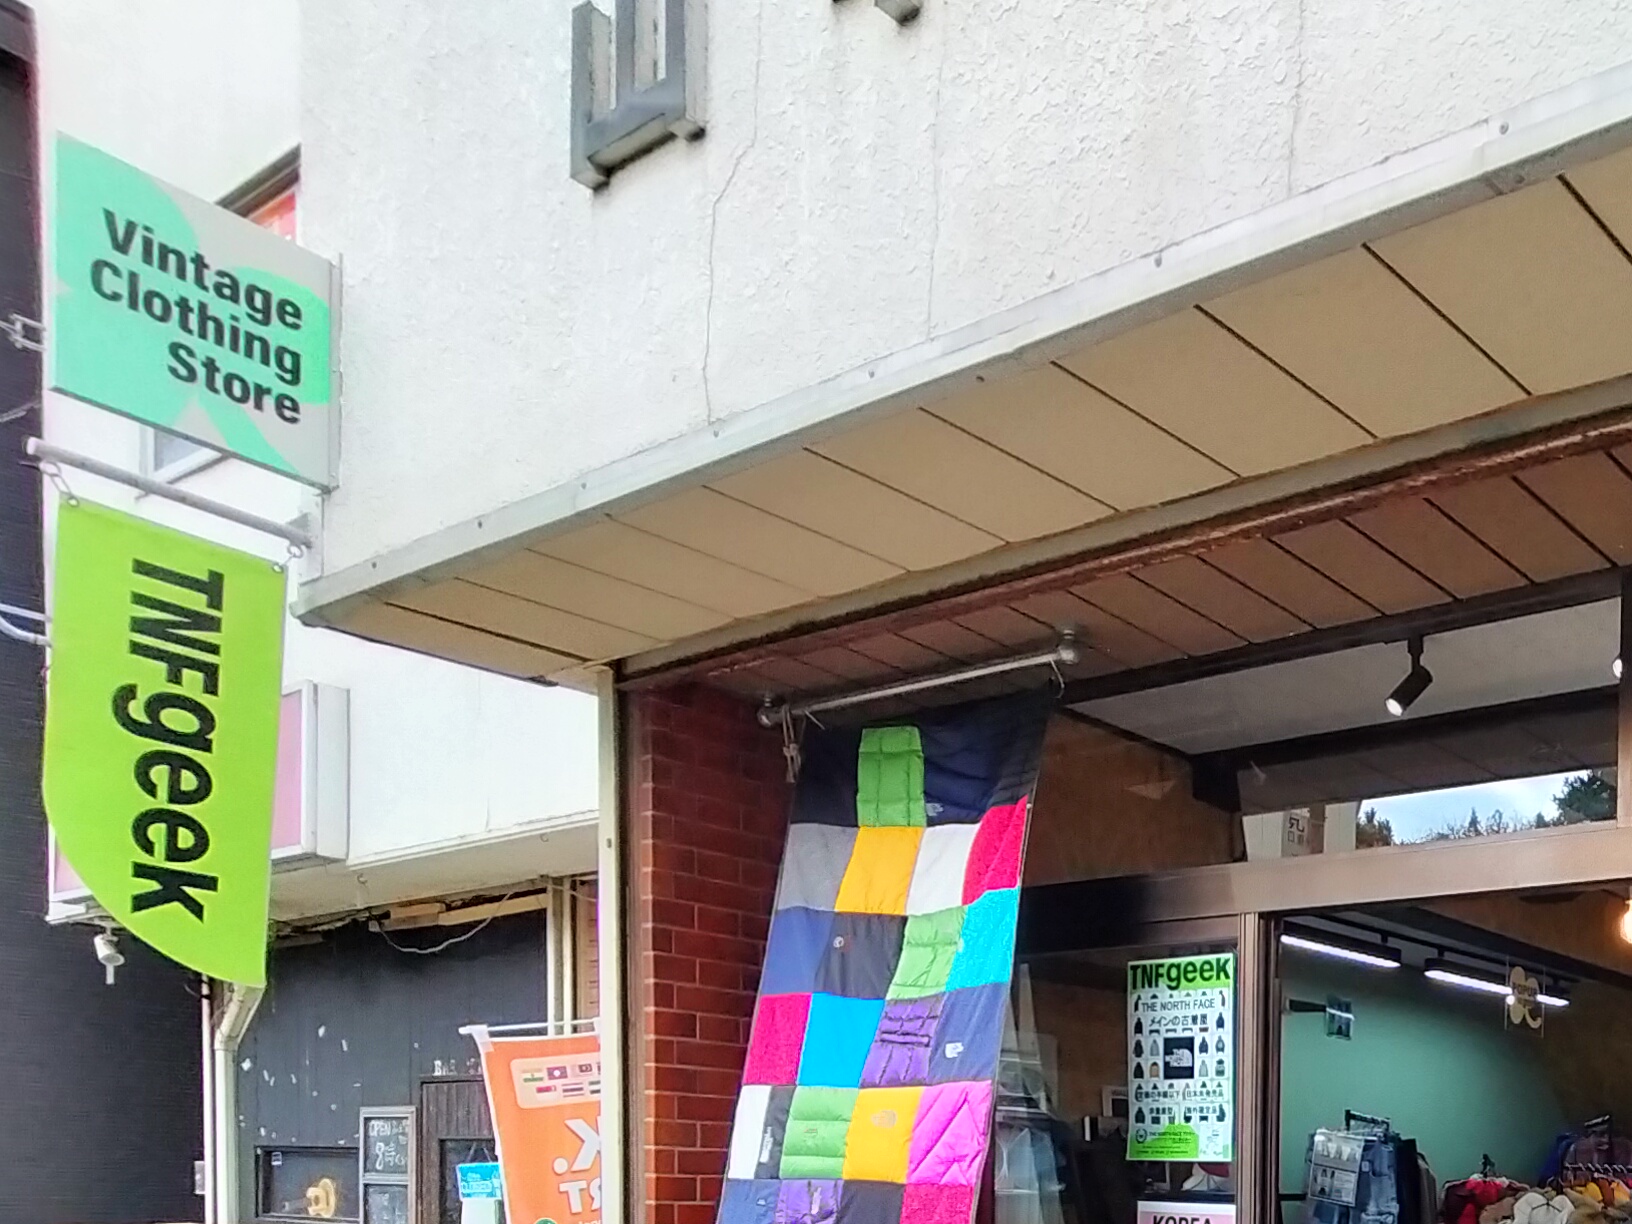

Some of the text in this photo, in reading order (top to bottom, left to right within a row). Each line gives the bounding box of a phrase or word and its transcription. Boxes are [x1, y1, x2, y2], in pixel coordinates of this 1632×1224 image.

[102, 206, 303, 331] Vintage
[90, 259, 302, 386] Clothing
[167, 341, 301, 425] Store
[112, 557, 225, 924] TNFgeek
[1130, 957, 1231, 991] TNFgeek
[1141, 998, 1216, 1012] THE NORTH FACE
